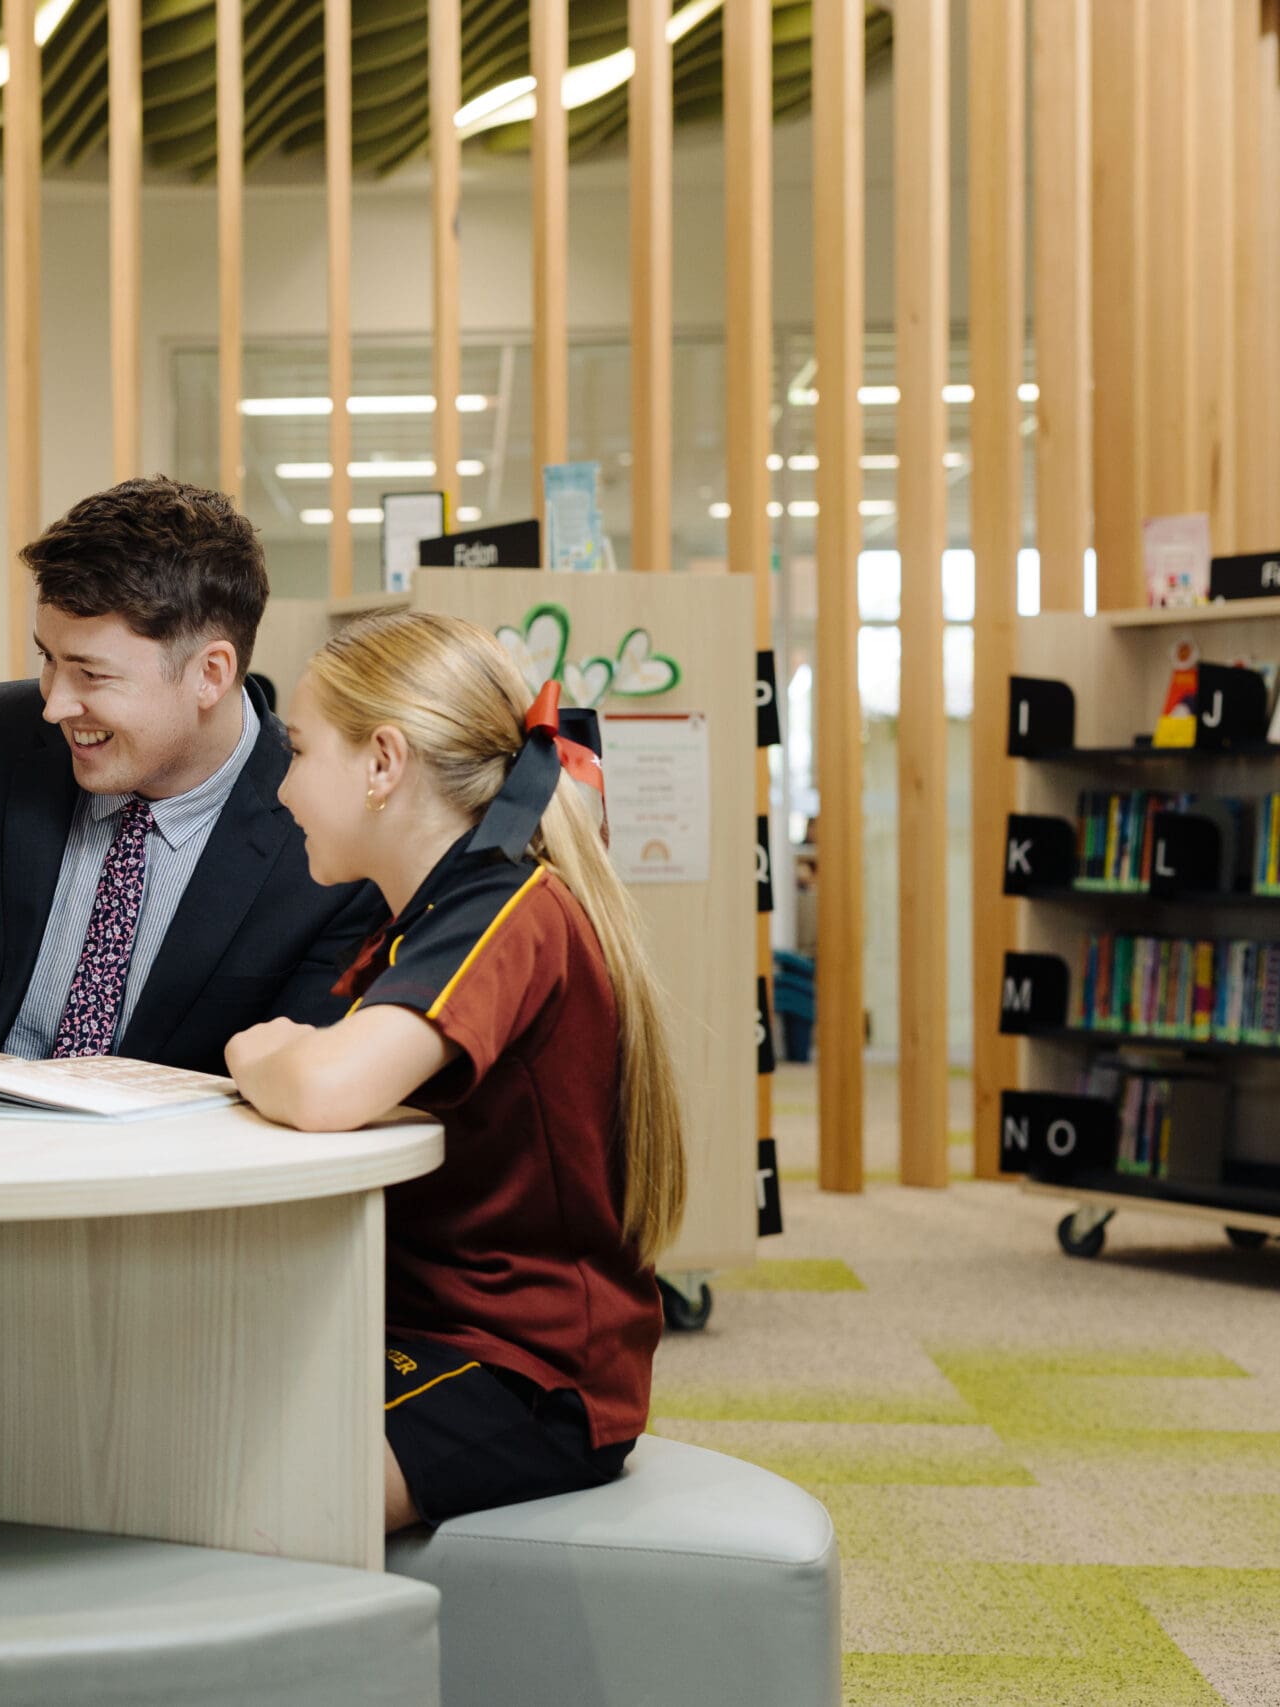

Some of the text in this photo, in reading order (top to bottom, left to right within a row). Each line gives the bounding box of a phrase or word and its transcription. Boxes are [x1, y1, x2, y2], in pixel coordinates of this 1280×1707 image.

[1019, 699, 1030, 737] I
[1202, 690, 1223, 728] J
[1007, 838, 1032, 875] K
[1155, 838, 1176, 877] L
[1002, 977, 1032, 1012] M
[1003, 1116, 1077, 1157] N O
